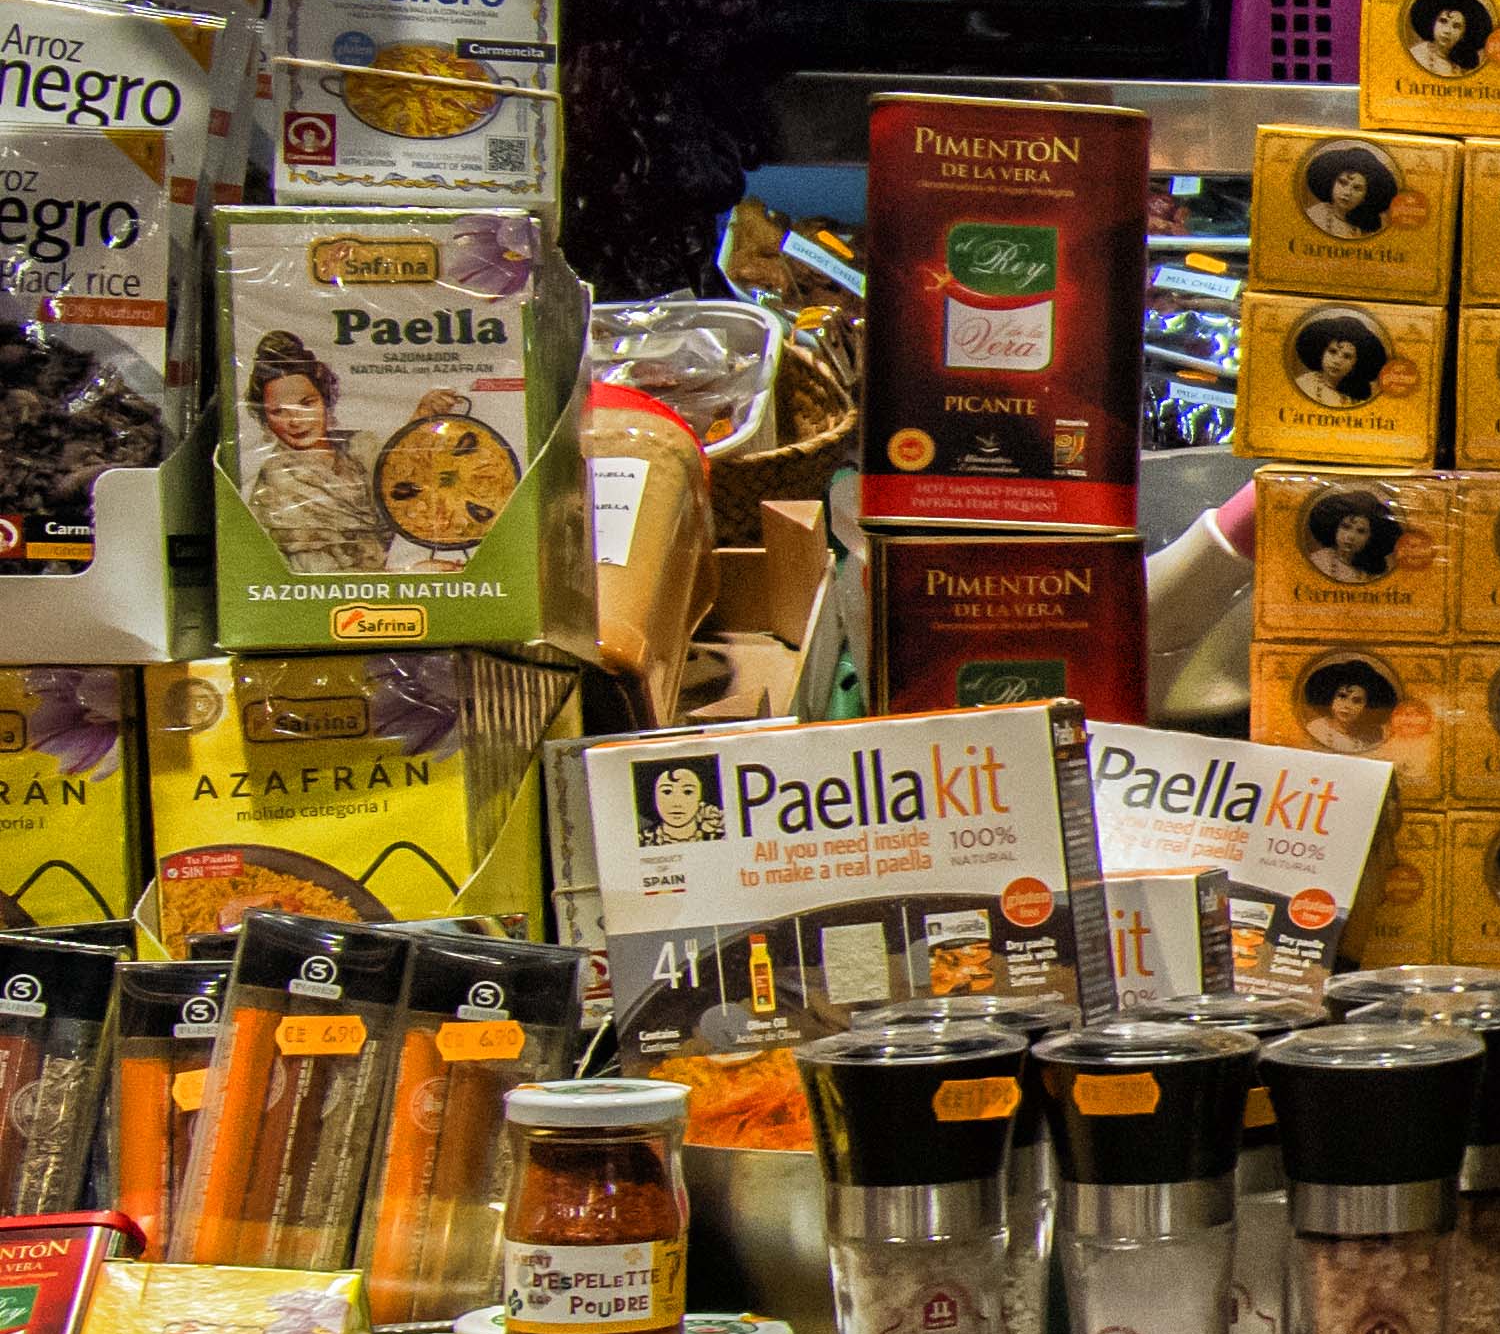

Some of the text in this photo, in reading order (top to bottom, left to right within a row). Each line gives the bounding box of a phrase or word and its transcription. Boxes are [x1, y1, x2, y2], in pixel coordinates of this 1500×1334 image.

[1, 21, 84, 63] Arroz
[469, 42, 545, 60] Carmencita
[0, 63, 182, 129] negro
[913, 123, 1081, 165] PIMENTÓN
[941, 161, 1051, 185] DE LA VERA
[1288, 235, 1406, 264] Carmencita
[85, 264, 142, 299] rice
[331, 307, 508, 347] Paella
[381, 351, 461, 364] SAZONADOR
[944, 394, 1037, 416] PICANTE
[1277, 406, 1396, 433] Carmencita
[911, 495, 966, 510] PAPRIKA
[949, 484, 1056, 501] SMOKED PAPRIKA
[247, 581, 508, 603] SAZONADOR NATURAL
[926, 567, 1093, 599] PIMENTÓN
[1012, 599, 1066, 618] VERA
[356, 617, 417, 635] Safrina
[193, 759, 433, 802] AZAFRÁN
[735, 743, 1012, 839] Paella kit
[1095, 745, 1341, 837] Paella kit
[754, 828, 930, 862] All you need inside
[948, 825, 1017, 851] 100%
[1202, 826, 1250, 846] inside
[950, 851, 1017, 868] NATURAL
[1265, 839, 1327, 862] 100%
[643, 873, 687, 889] SPAIN
[740, 852, 934, 888] to make real paella
[308, 958, 330, 983] 3
[651, 940, 684, 990] 4
[11, 977, 33, 999] 3
[319, 1019, 363, 1044] 6.90
